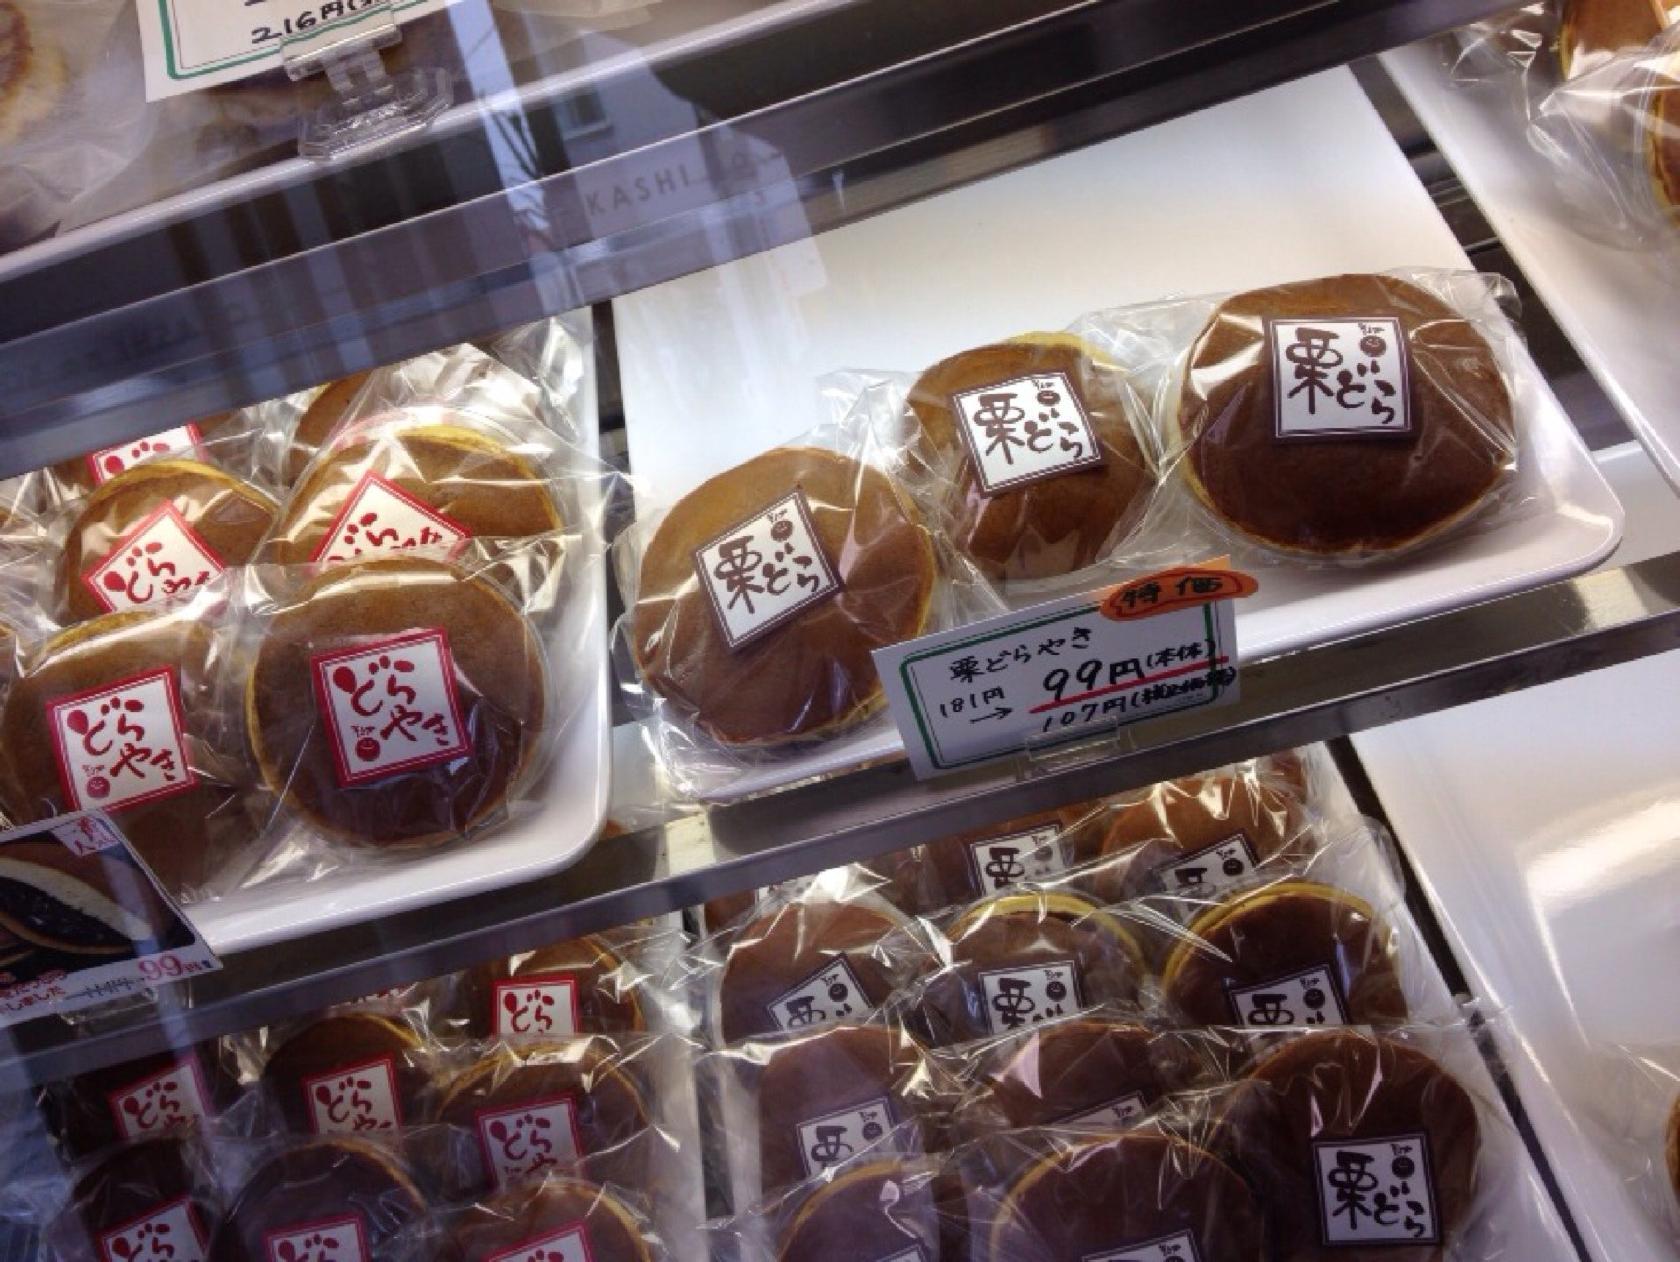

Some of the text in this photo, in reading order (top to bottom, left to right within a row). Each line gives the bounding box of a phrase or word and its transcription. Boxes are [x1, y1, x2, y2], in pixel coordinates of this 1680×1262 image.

[1286, 327, 1396, 424] 栗どら
[974, 393, 1082, 465] 栗どら
[714, 535, 819, 614] 栗どら
[949, 626, 1092, 684] 栗どらやき
[333, 655, 417, 717] どら
[940, 686, 1005, 718] 181円
[67, 697, 144, 756] どら
[380, 704, 449, 746] やき
[110, 743, 176, 781] やき
[1329, 1150, 1425, 1238] 栗どら
